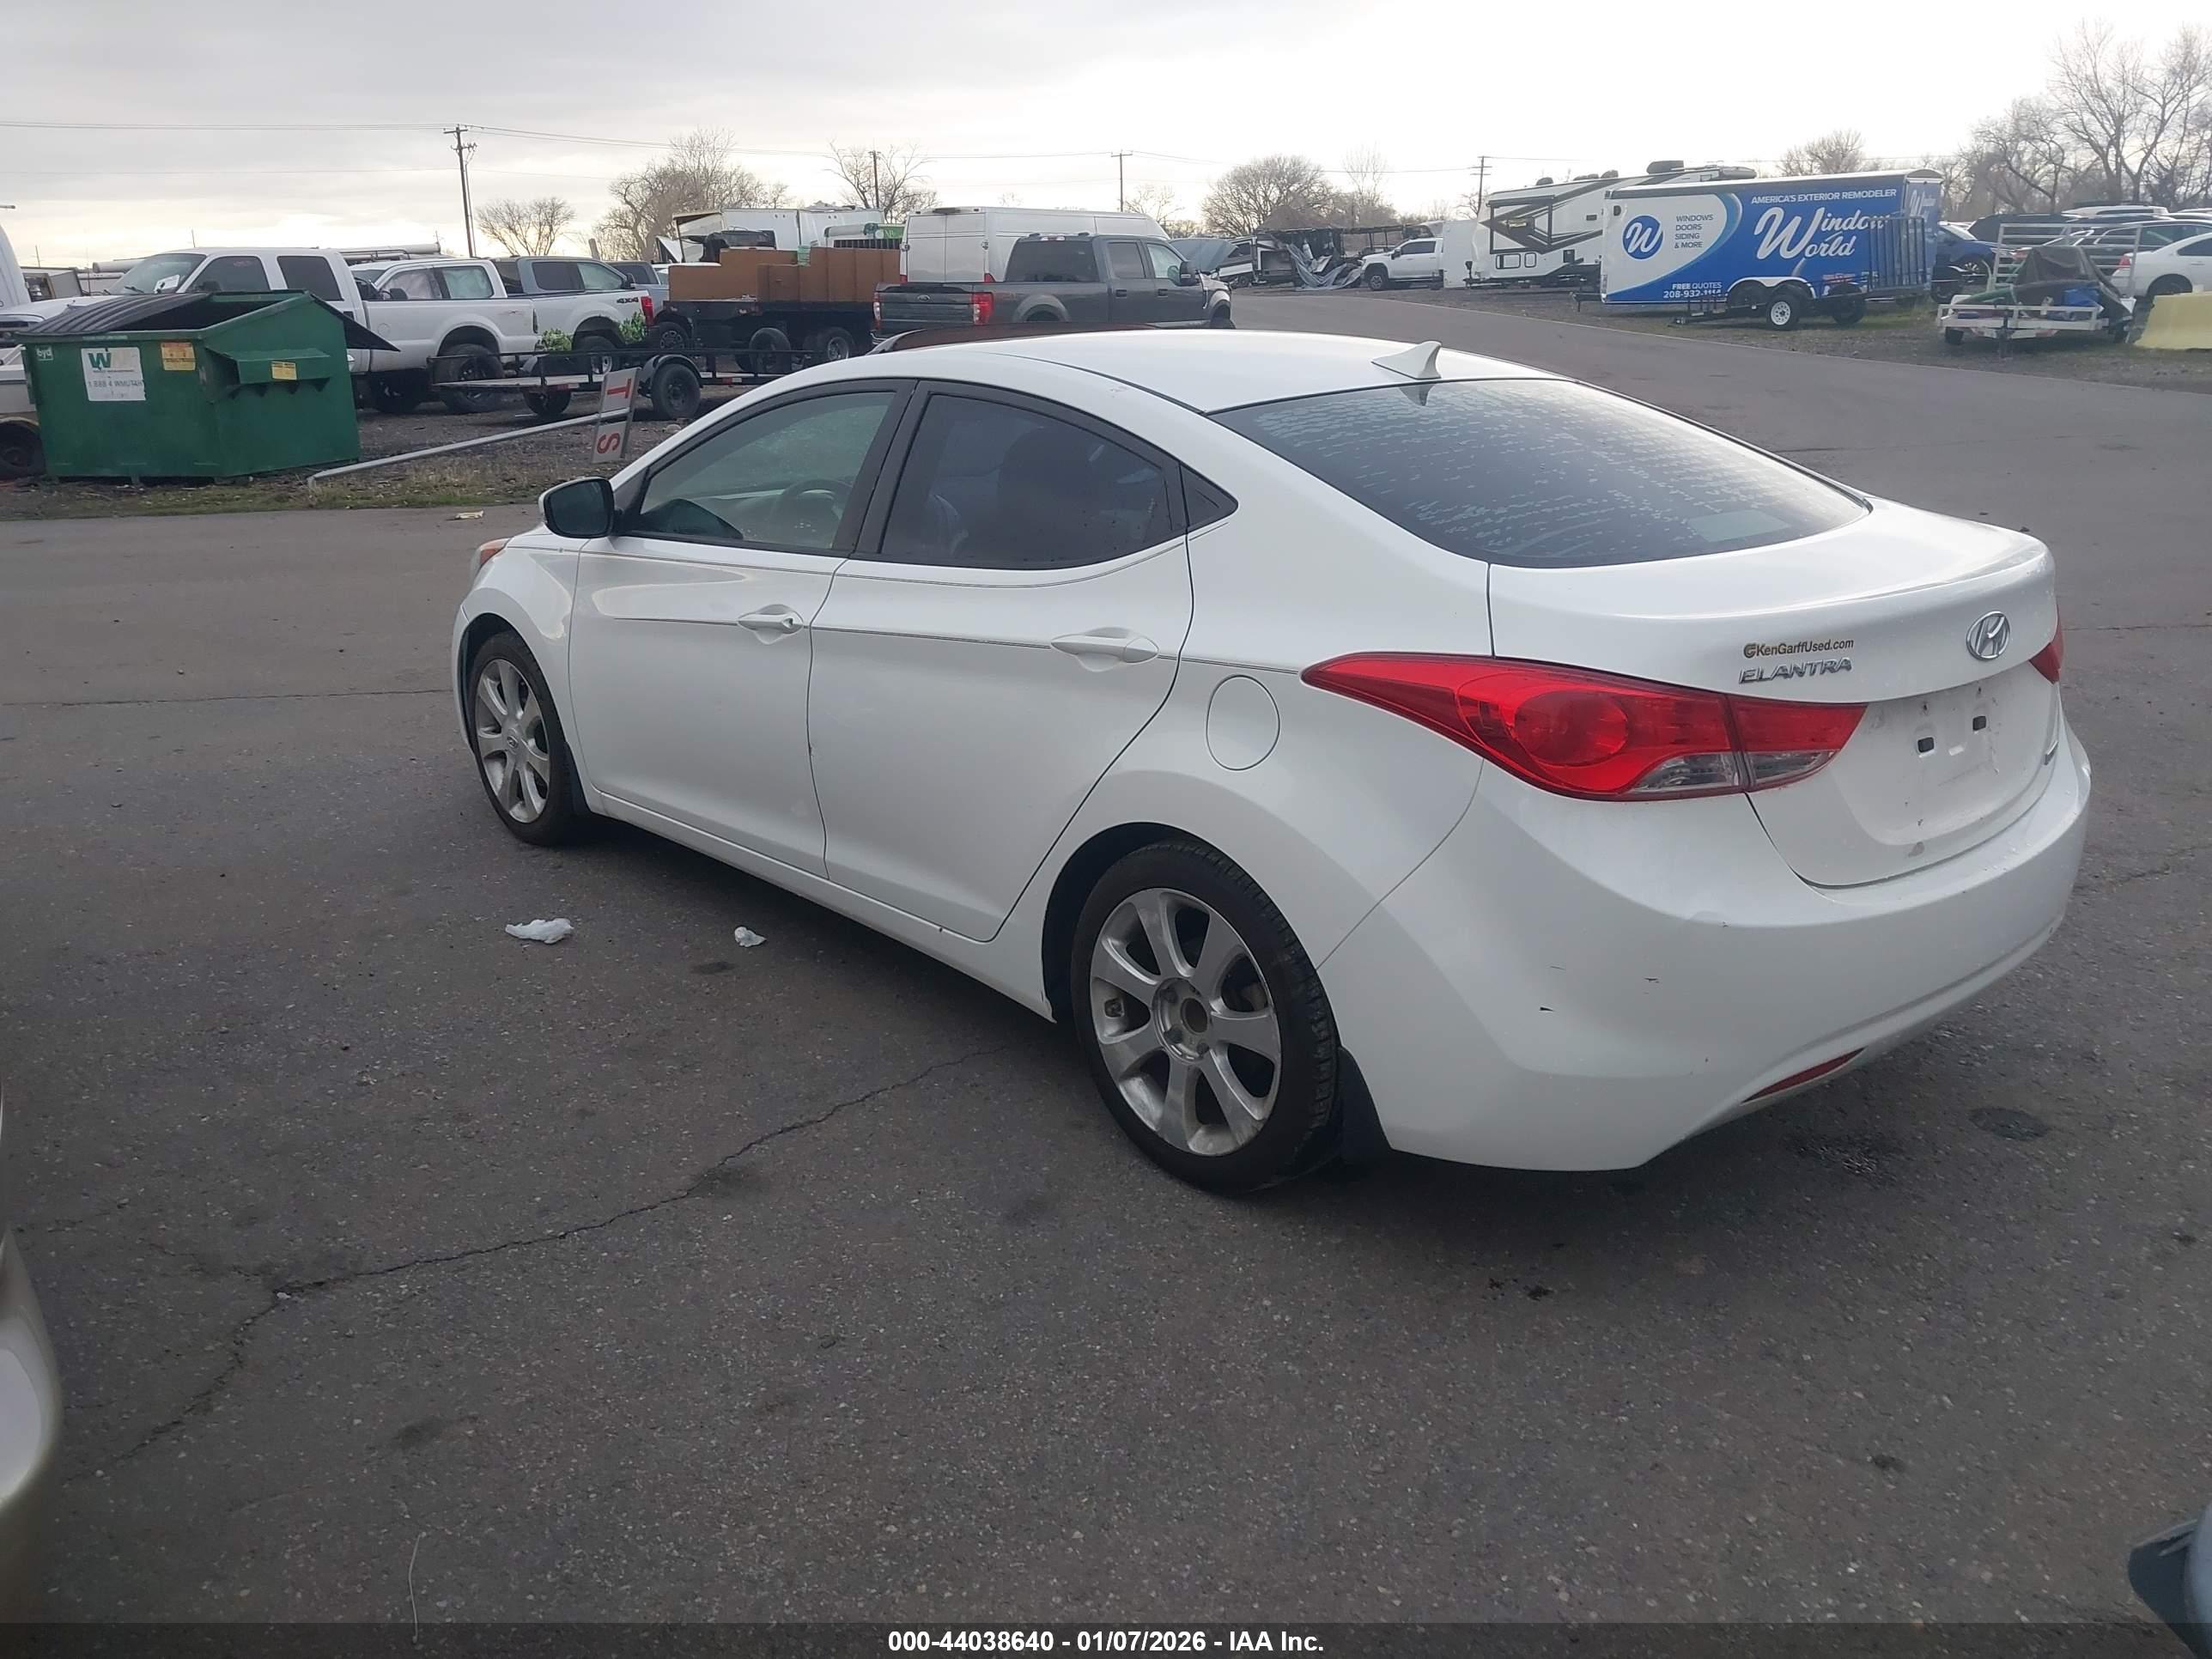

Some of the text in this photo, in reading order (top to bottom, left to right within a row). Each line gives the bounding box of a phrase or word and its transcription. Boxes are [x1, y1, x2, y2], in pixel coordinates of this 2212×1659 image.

[1751, 189, 1897, 204] AMERICA'S EXTERIOR REMODELER
[1738, 657, 1853, 684] ELANTRA
